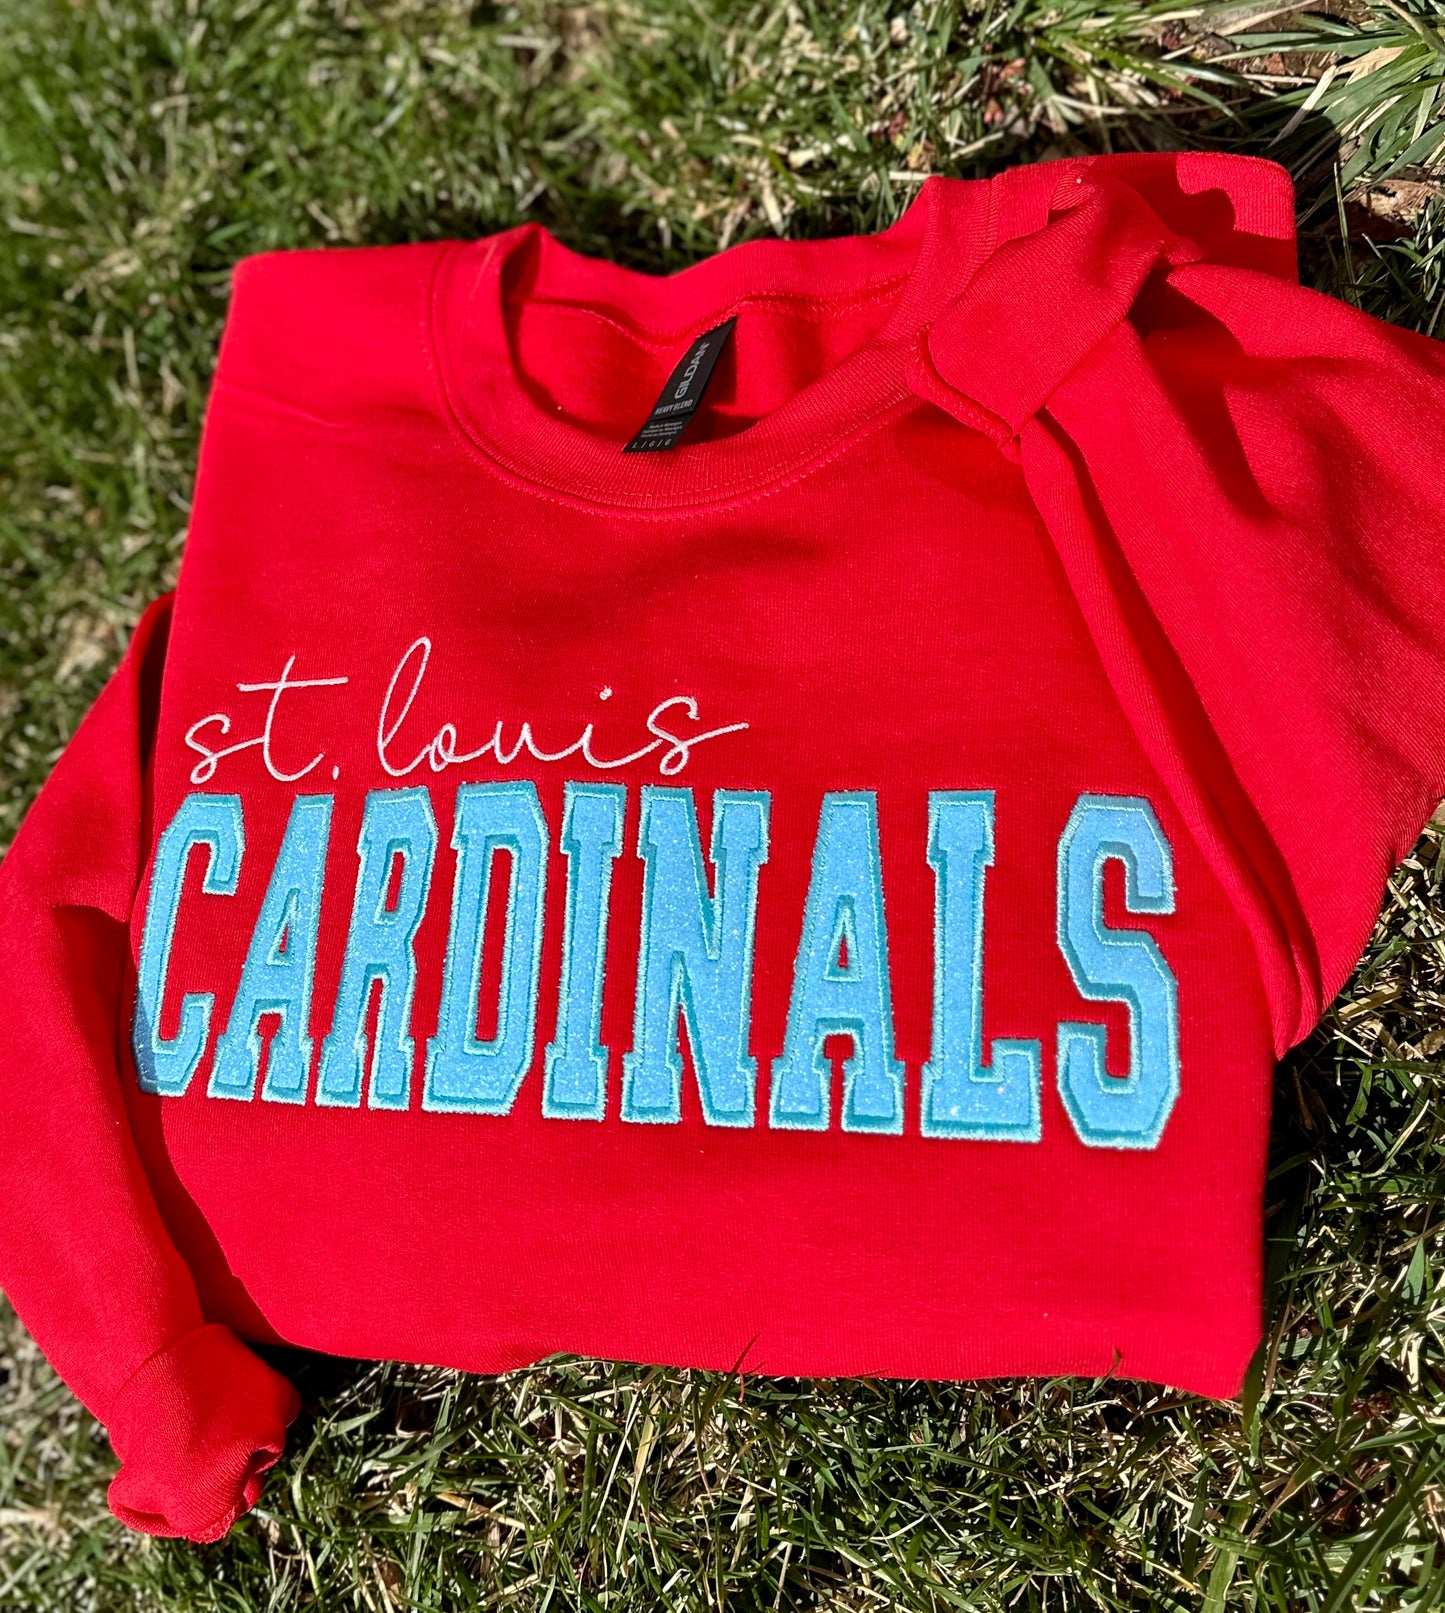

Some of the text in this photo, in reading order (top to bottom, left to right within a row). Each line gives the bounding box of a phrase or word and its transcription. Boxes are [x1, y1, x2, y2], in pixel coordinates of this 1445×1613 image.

[655, 404, 674, 416] HEAVY
[675, 342, 711, 399] GILDAN
[185, 637, 749, 784] st. louis
[131, 781, 1180, 1150] CARDINALS
